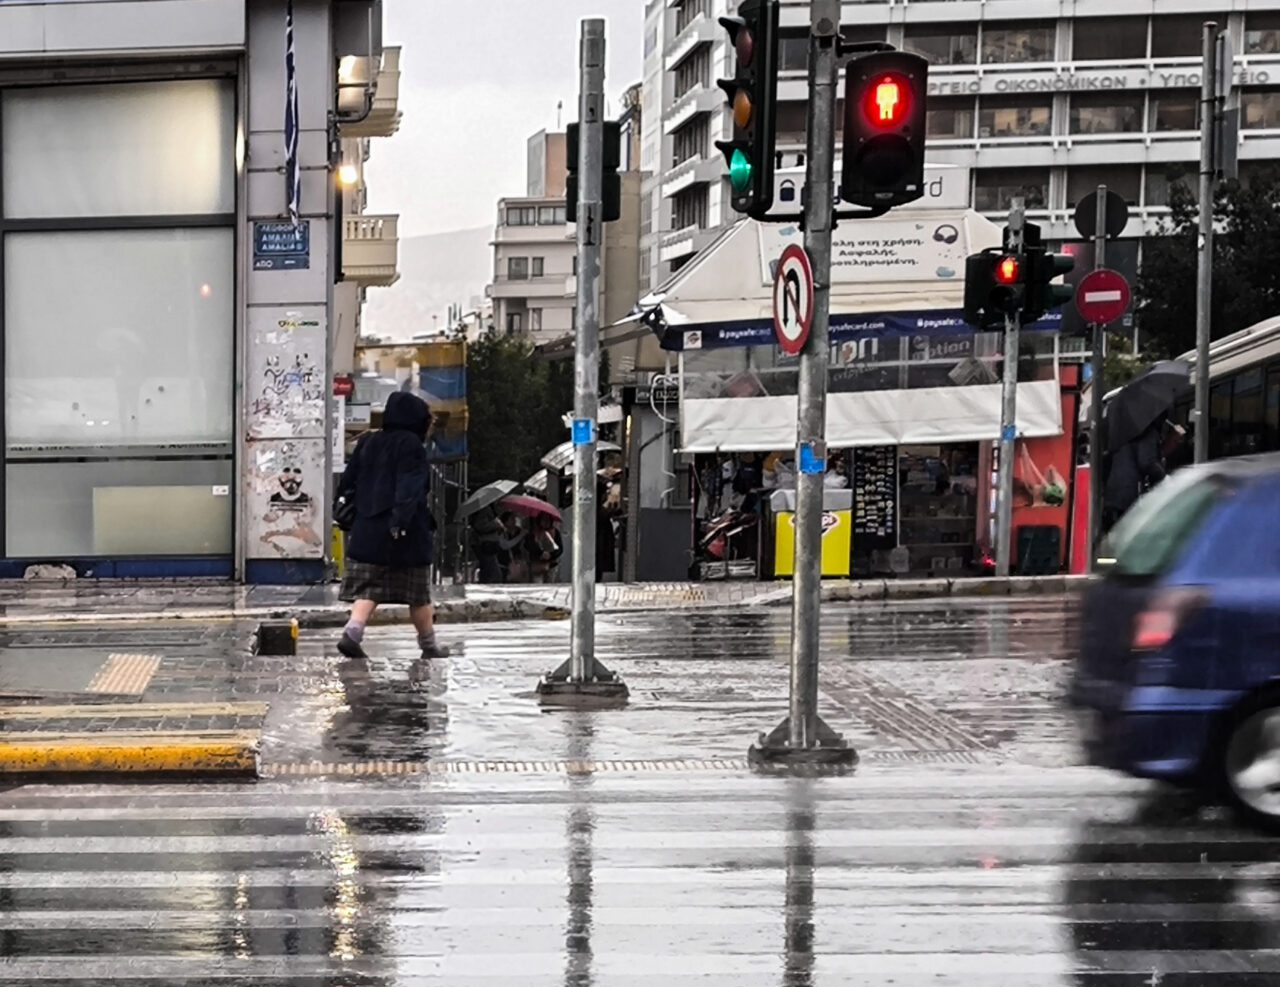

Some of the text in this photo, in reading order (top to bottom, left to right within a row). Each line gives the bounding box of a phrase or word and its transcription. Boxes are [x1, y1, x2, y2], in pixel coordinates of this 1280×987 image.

[928, 70, 1270, 94] ΡΓΕΙΟ ΟΙΚΟΝΟΜΙΚΩΝ ΥΠΟΕΙΟ
[839, 249, 897, 257] Ασφαλής.
[831, 259, 918, 267] οπληρωμένη.
[923, 318, 965, 328] paysafeca
